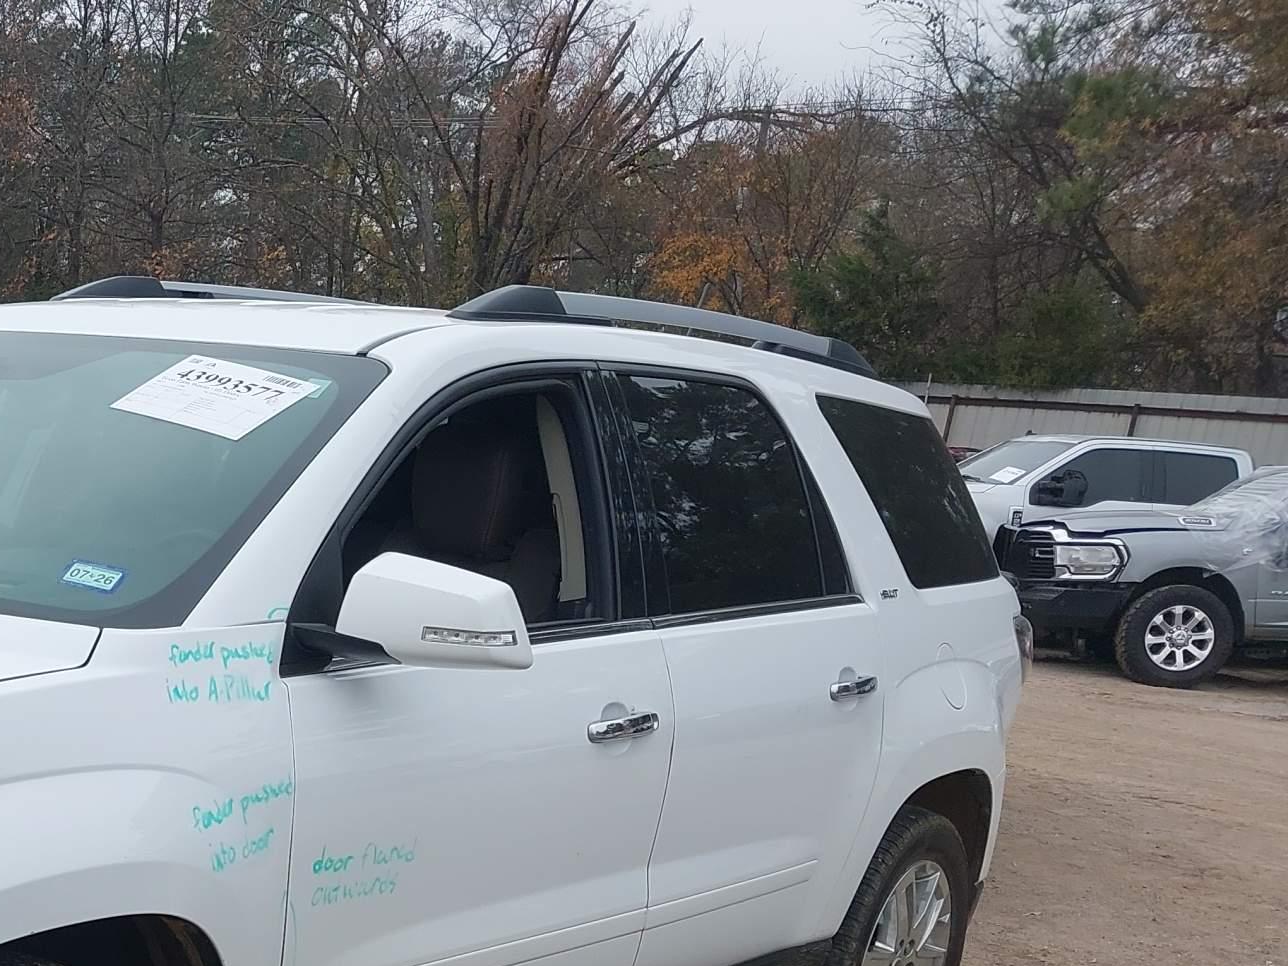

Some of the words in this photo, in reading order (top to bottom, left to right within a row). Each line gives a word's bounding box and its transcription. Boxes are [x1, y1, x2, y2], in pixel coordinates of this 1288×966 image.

[177, 368, 285, 401] 43993577
[166, 678, 200, 704] into
[208, 842, 236, 873] into
[242, 828, 275, 859] door
[312, 846, 354, 875] door
